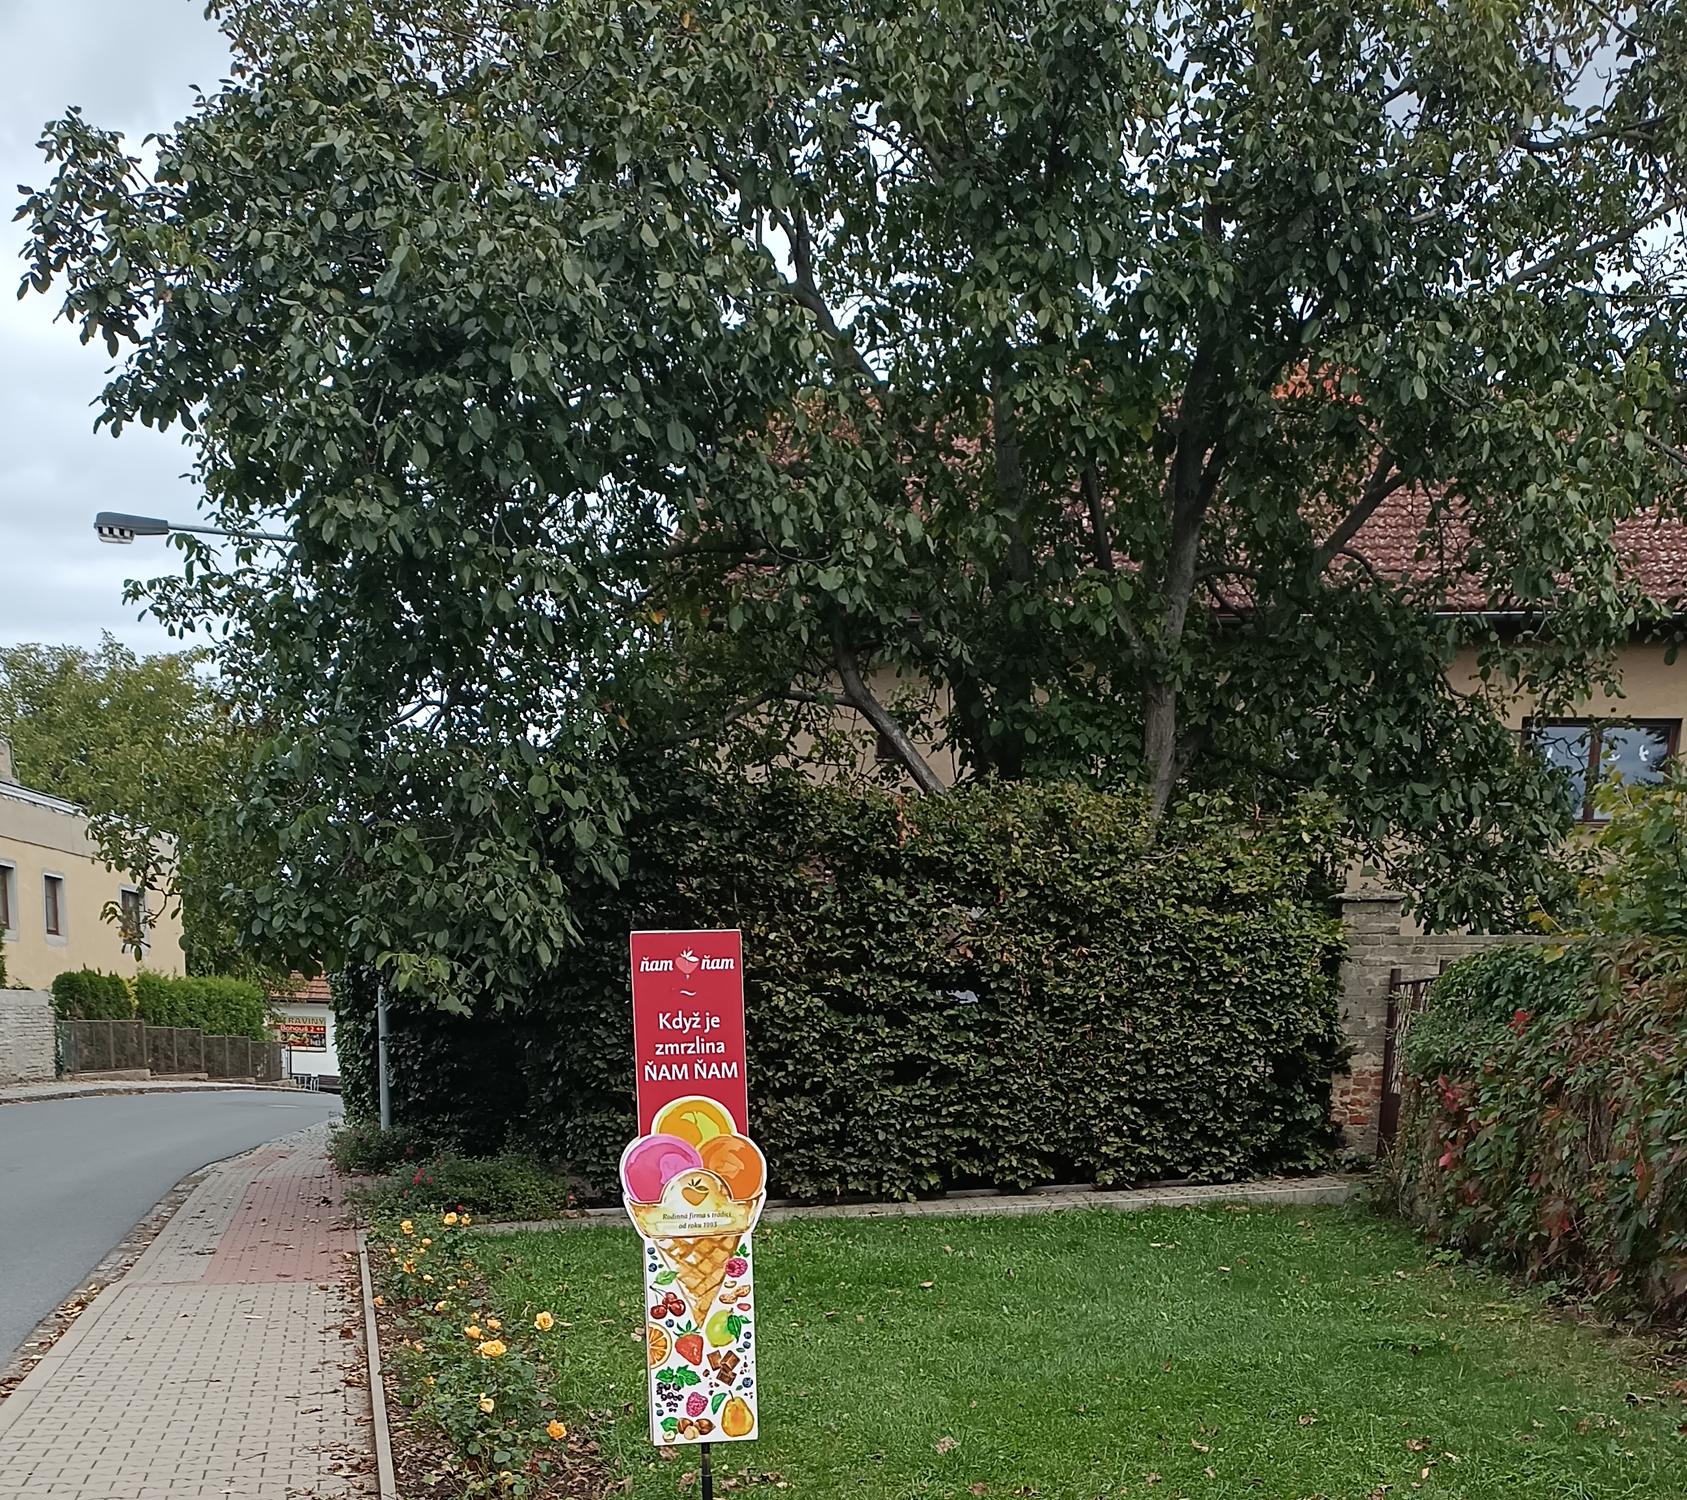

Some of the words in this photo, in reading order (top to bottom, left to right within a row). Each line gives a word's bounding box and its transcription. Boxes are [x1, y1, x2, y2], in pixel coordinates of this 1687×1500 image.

[640, 956, 673, 972] ňam
[701, 955, 735, 970] ňam
[658, 1010, 702, 1034] Když
[703, 1012, 721, 1033] je
[655, 1036, 725, 1055] zmrzlina
[644, 1061, 689, 1081] ŇAM
[694, 1059, 739, 1080] ŇAM
[689, 1212, 706, 1220] firma
